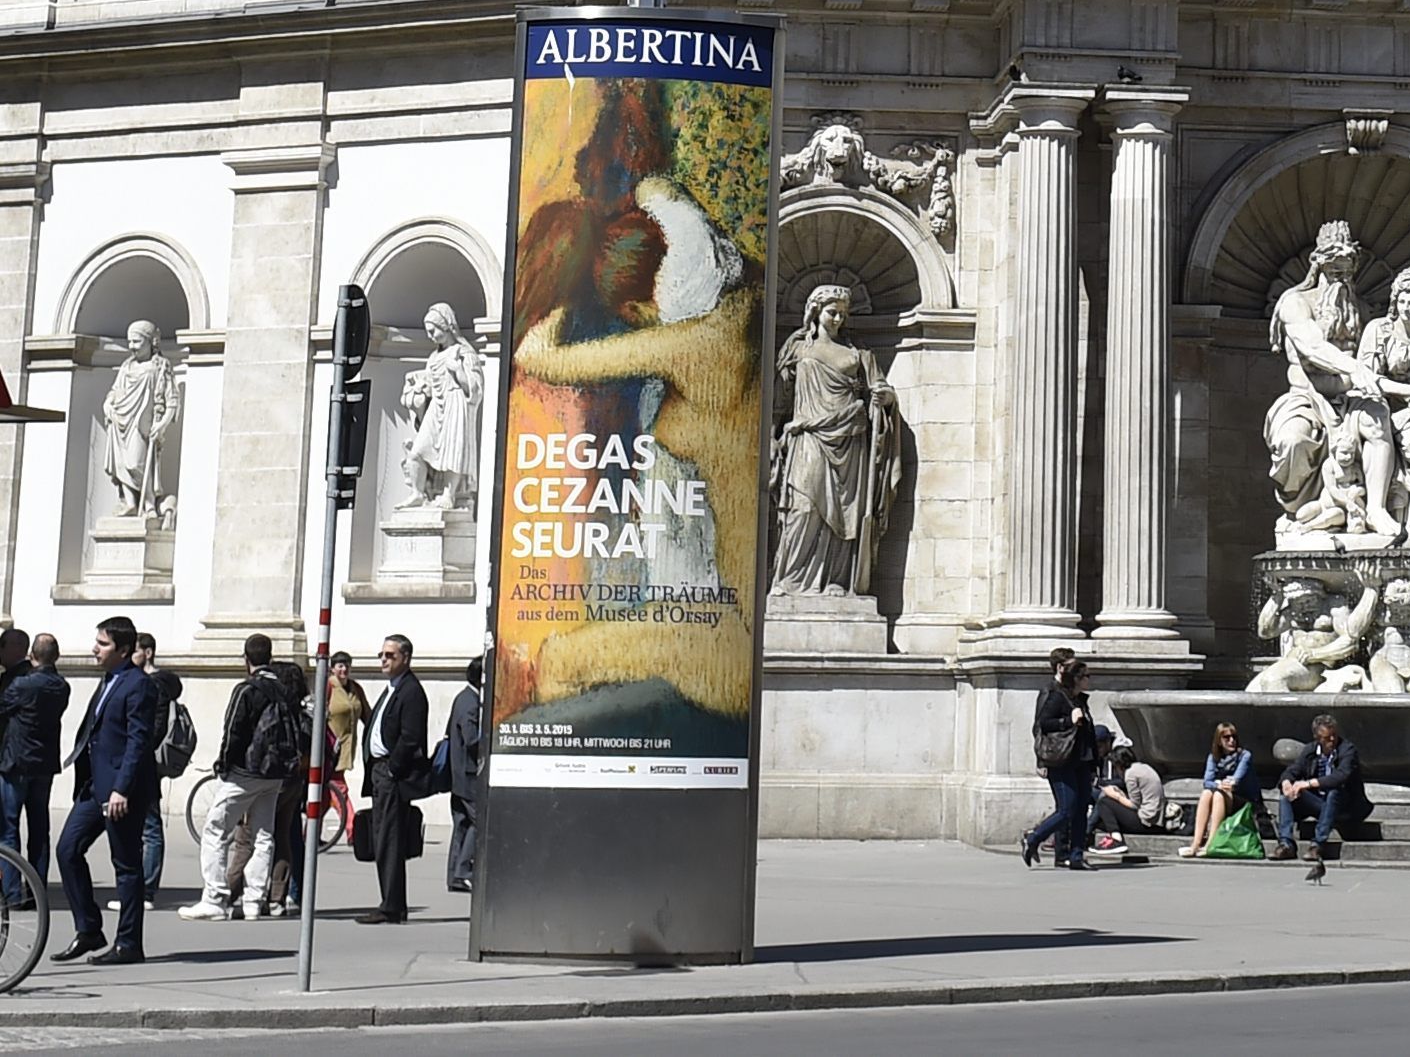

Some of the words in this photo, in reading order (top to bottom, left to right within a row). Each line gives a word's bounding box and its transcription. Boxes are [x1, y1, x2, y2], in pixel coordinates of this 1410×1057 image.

[535, 28, 763, 73] ALBERTINA
[516, 433, 656, 471] DEGAS
[512, 476, 706, 517] CEZANNE
[510, 521, 666, 559] SEURAT
[519, 564, 547, 580] Das
[510, 583, 593, 603] ARCHIV
[597, 584, 642, 603] DER
[649, 580, 739, 606] TRÄUME
[516, 611, 542, 622] aus
[545, 606, 580, 622] dem
[585, 603, 649, 623] Musée
[652, 605, 723, 629] d’Orsay
[539, 736, 553, 748] BIS
